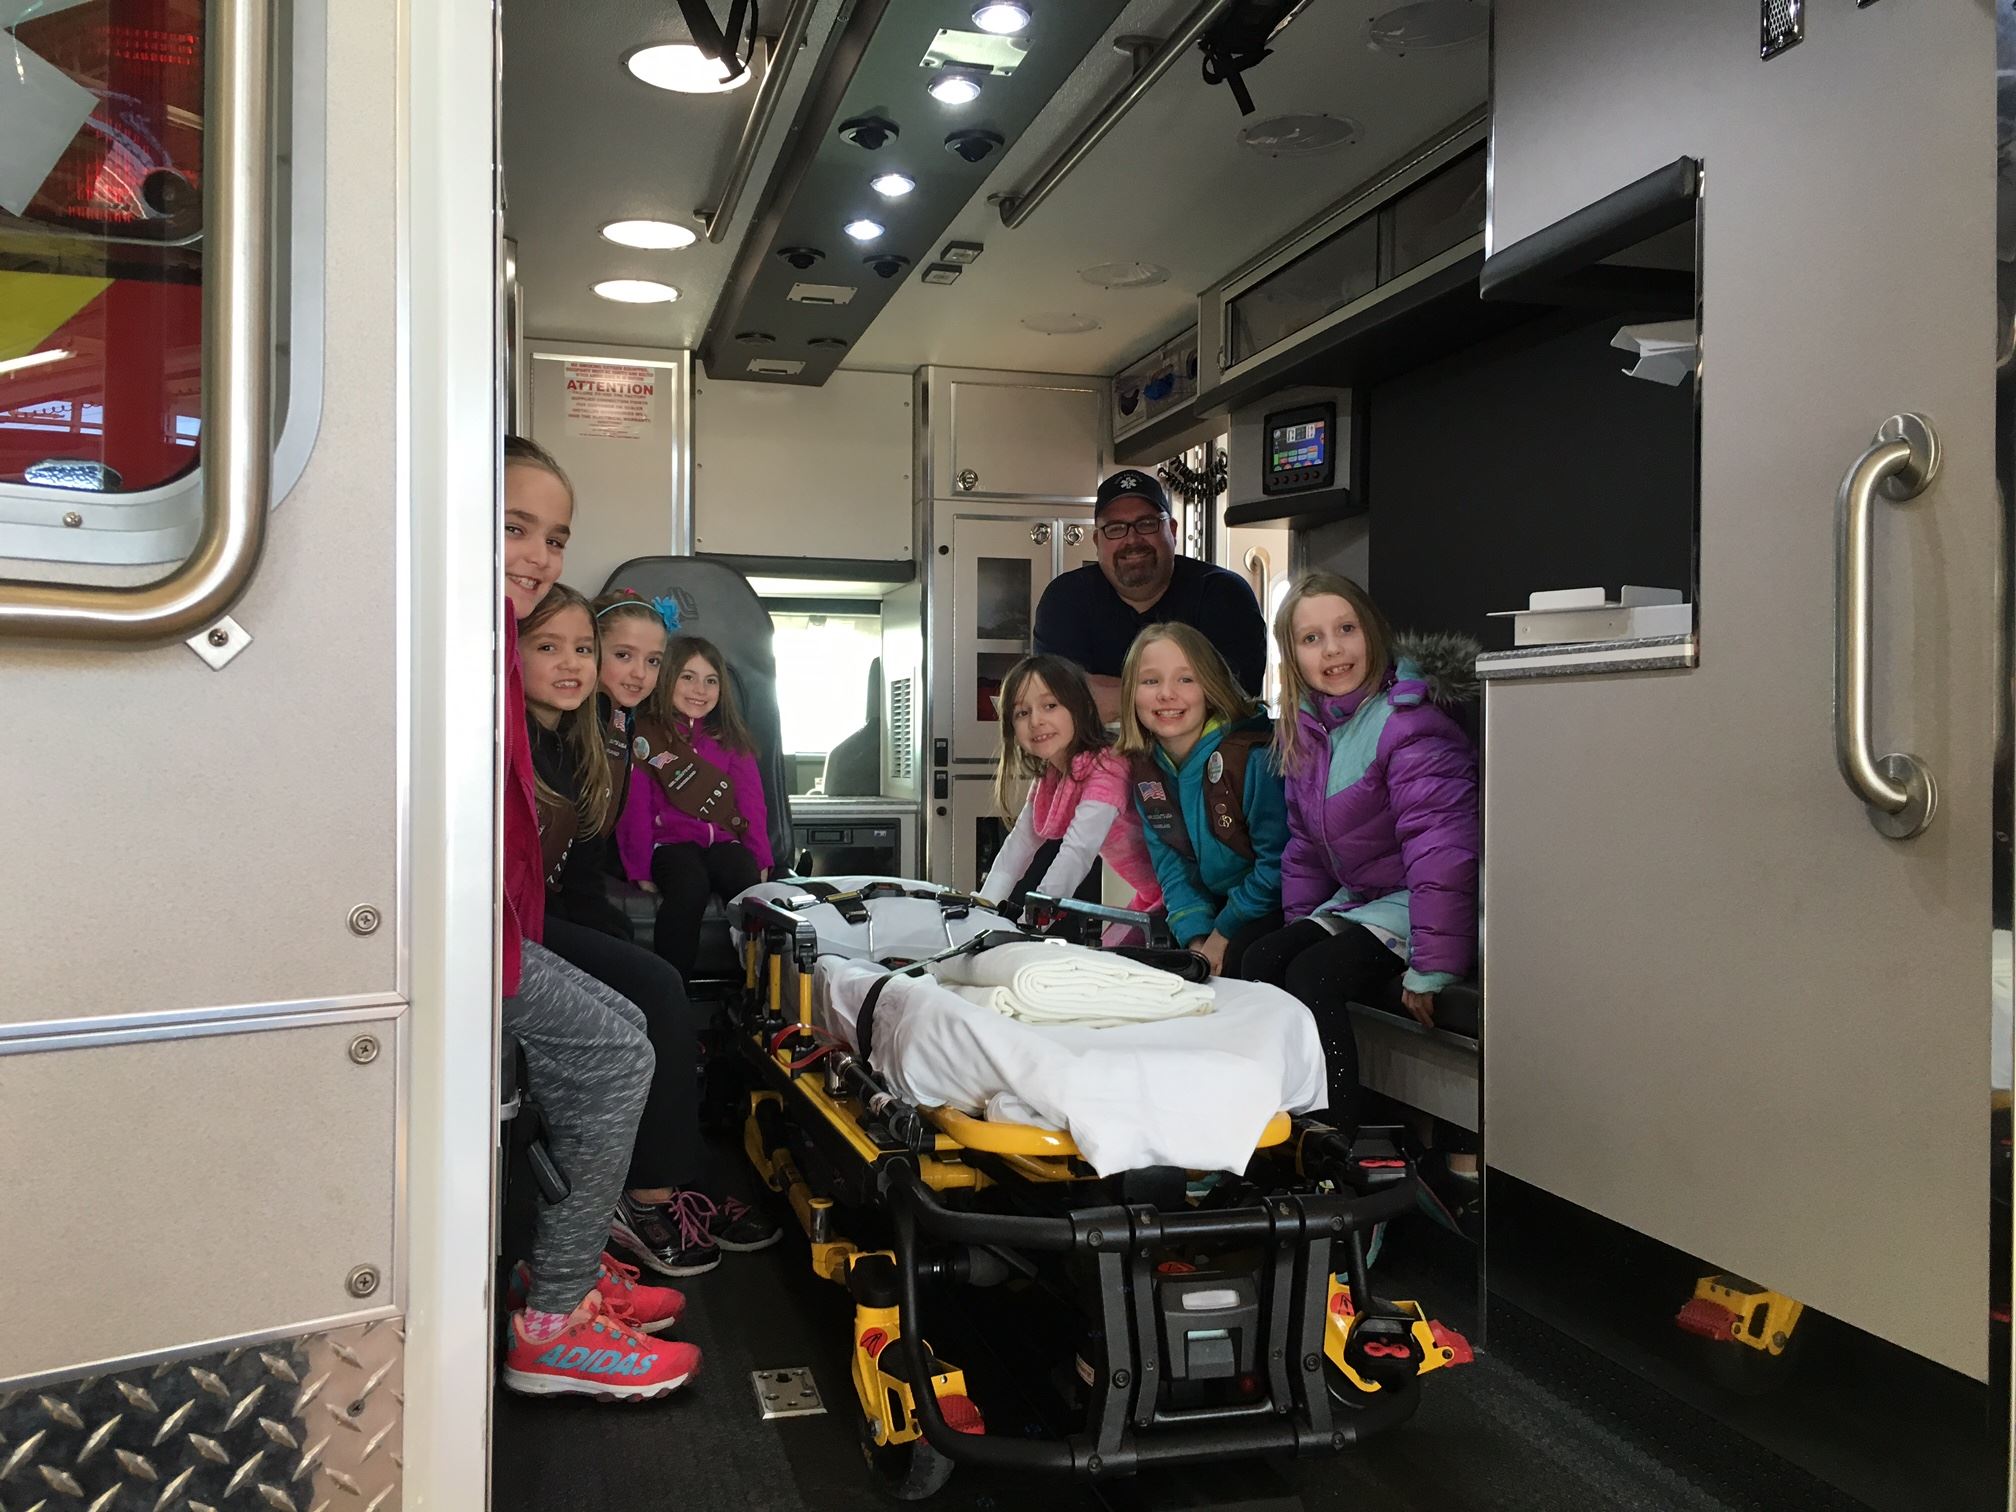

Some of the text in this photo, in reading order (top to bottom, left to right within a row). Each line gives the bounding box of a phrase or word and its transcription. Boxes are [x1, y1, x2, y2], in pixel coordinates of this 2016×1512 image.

[567, 379, 654, 396] ATTENTION
[699, 780, 728, 814] 7790
[534, 1344, 660, 1376] ADIDAS
